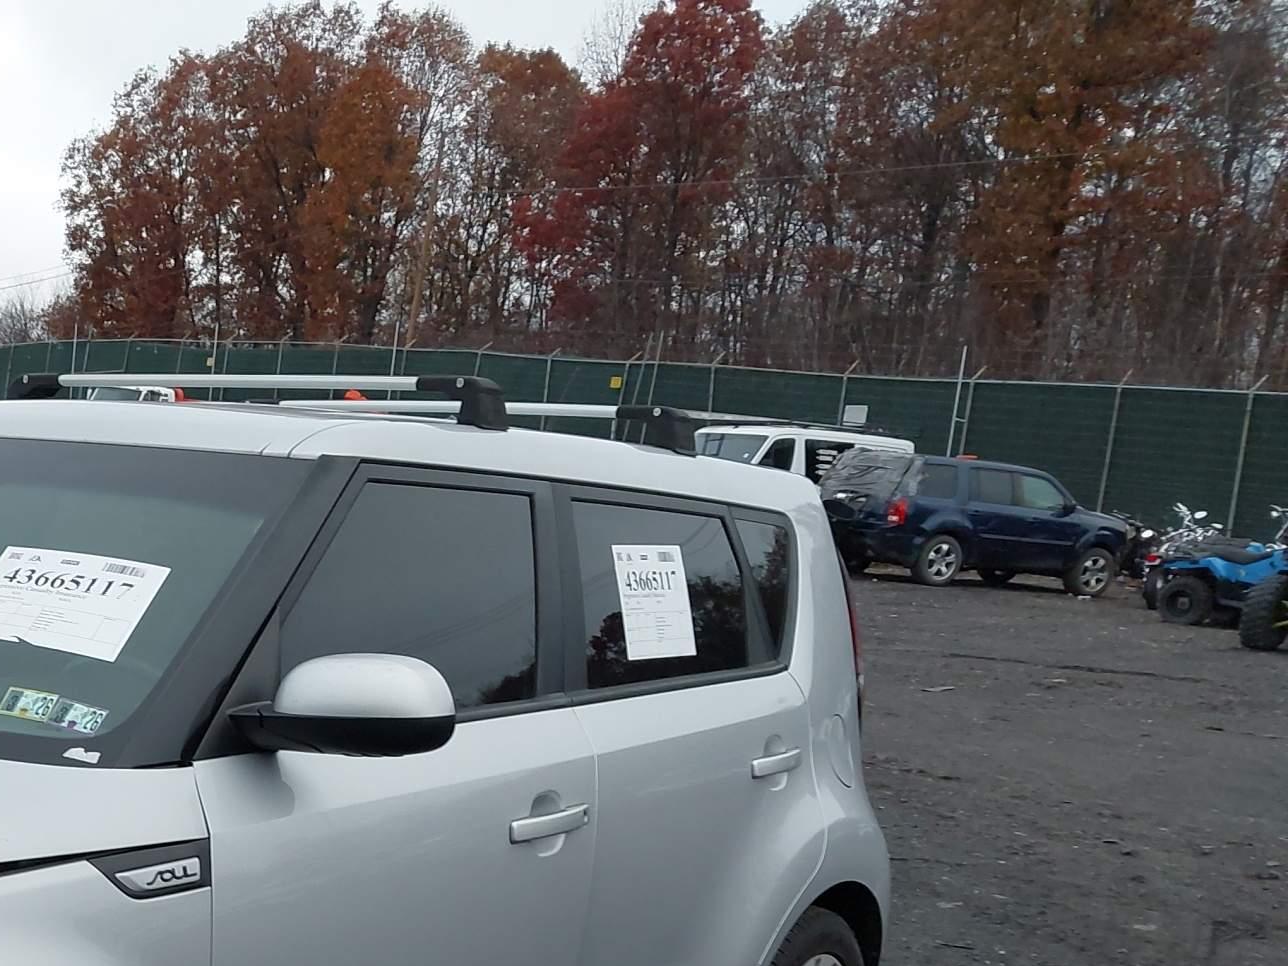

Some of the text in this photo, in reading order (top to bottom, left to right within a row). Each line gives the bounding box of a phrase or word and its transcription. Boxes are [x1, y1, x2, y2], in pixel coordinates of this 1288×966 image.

[4, 567, 134, 599] 43665117
[35, 696, 54, 717] 26
[83, 711, 104, 731] 26
